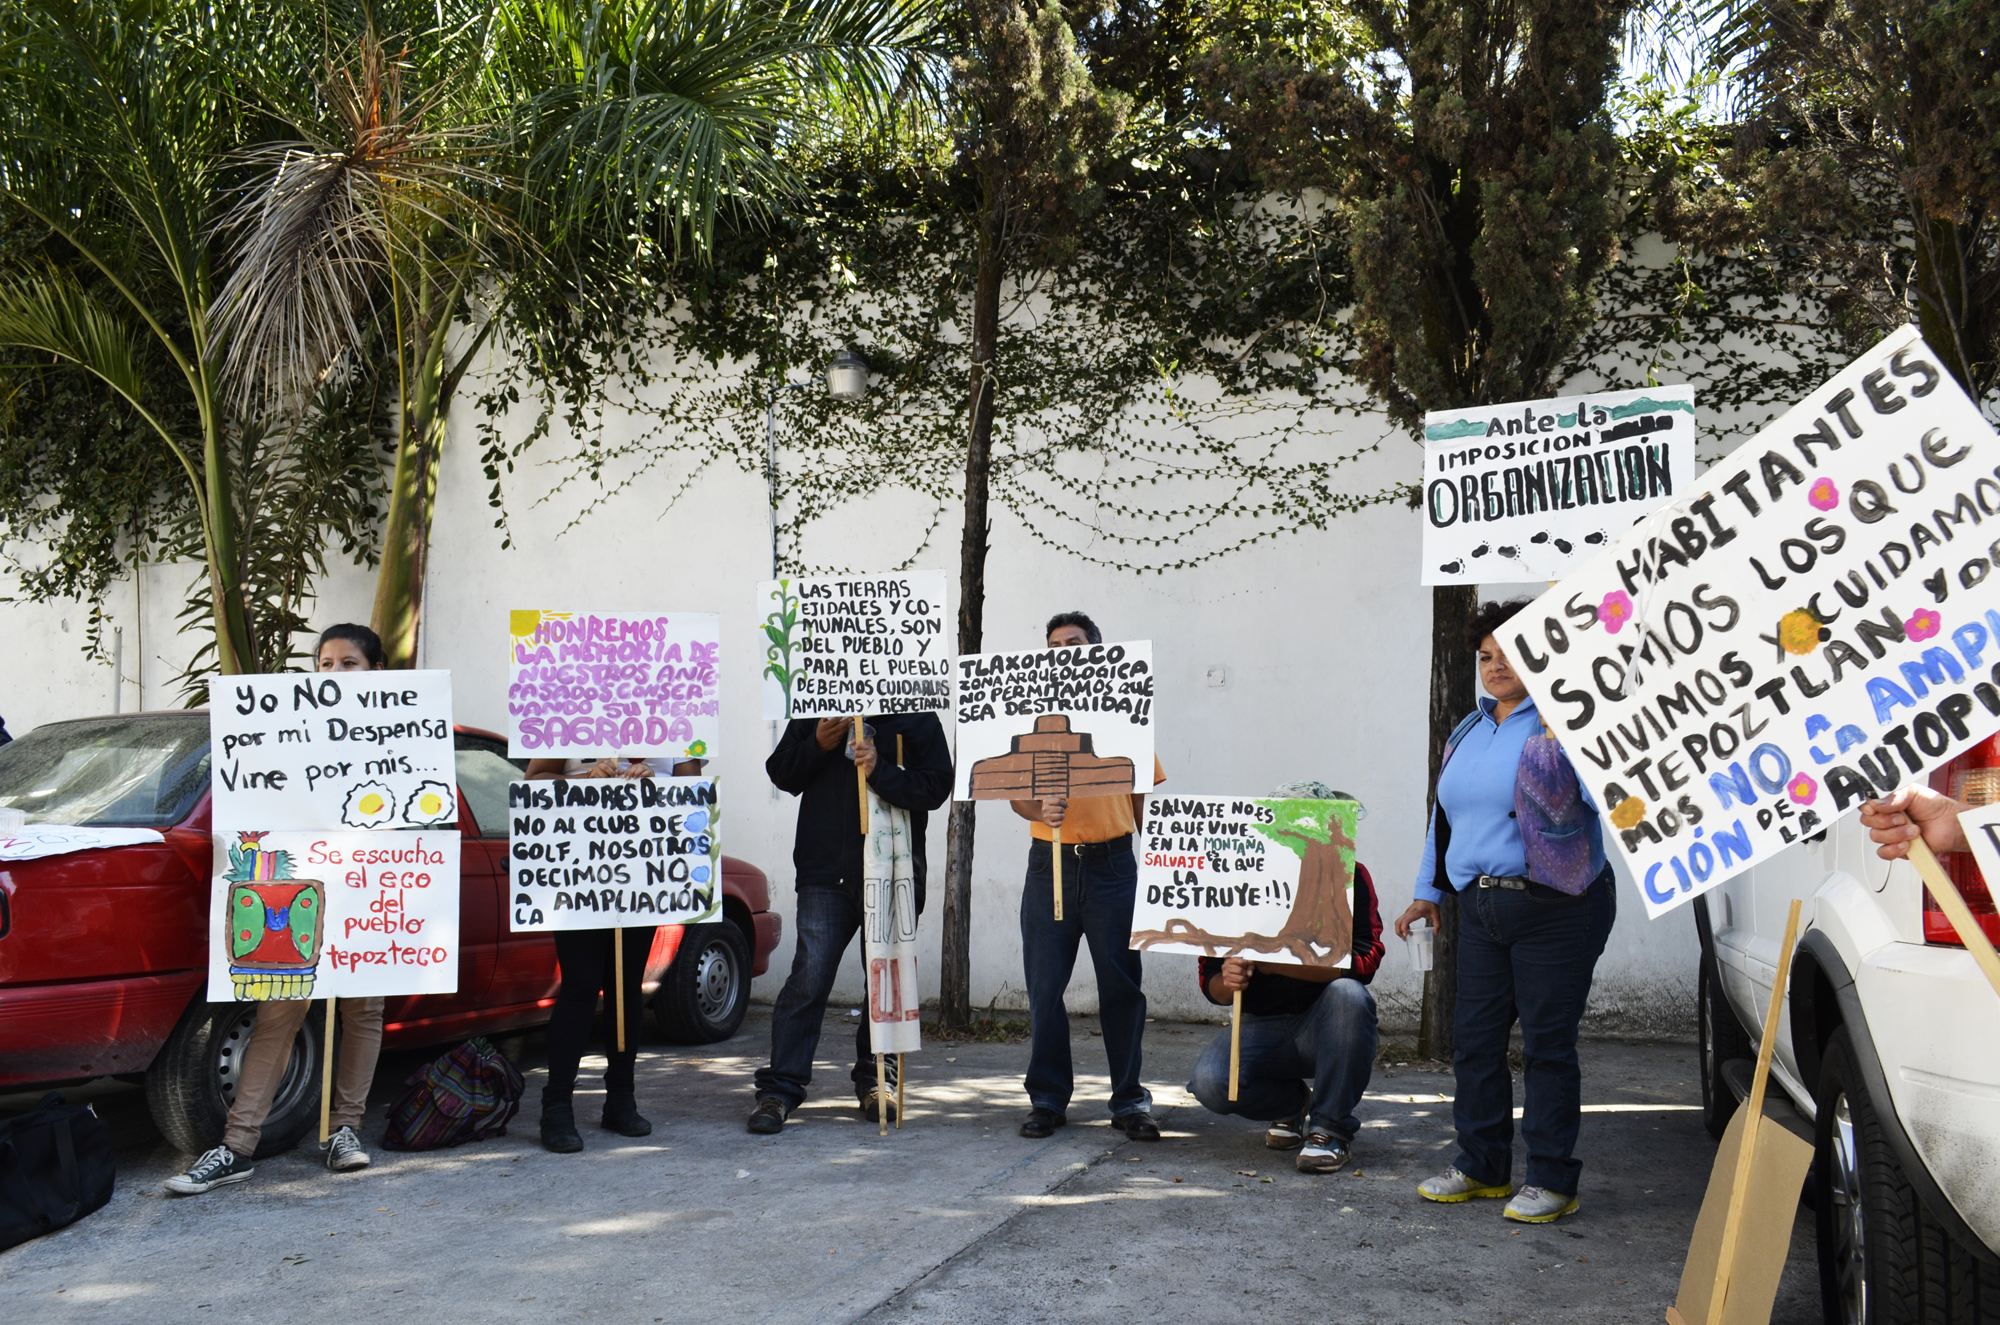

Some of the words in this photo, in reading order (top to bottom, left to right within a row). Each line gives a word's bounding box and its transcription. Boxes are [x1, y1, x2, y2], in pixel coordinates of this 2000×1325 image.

[1486, 407, 1555, 437] Ante
[1438, 431, 1591, 472] IMPOSICION
[1427, 436, 1672, 528] ORGANIZACIÓN
[1514, 591, 1599, 673] LOS
[1615, 349, 1940, 596] HABITANTES
[799, 582, 832, 599] LAS
[835, 580, 911, 598] TIERRAS
[1550, 582, 1740, 731] SOMOS
[1749, 516, 1846, 590] LOS
[1849, 427, 1972, 524] QUE
[1923, 567, 1948, 603] Y
[801, 600, 882, 616] EJIDALES
[890, 600, 901, 615] Y
[1581, 651, 1753, 770] VIVIMOS
[1808, 465, 2000, 624] CUIDAMO
[534, 614, 668, 644] HONREMOS
[802, 617, 896, 635] MUNALES,
[900, 617, 941, 634] SON
[515, 644, 556, 665] LA
[559, 640, 683, 665] MEMORIA
[689, 640, 719, 663] DE
[801, 637, 835, 654] DEL
[842, 636, 904, 656] PUEBLO
[916, 638, 931, 657] Y
[517, 663, 651, 685] NUESTROS
[804, 657, 849, 678] PARA
[859, 659, 880, 676] EL
[888, 658, 949, 676] PUEBLO
[959, 645, 1125, 678] TLAXOMOLCO
[959, 675, 1003, 691] ZONA
[1005, 660, 1149, 685] ARQUEOLOGICA
[236, 684, 278, 715] Yo
[293, 678, 342, 711] NO
[357, 689, 418, 709] vine
[508, 682, 615, 702] PASADOS
[797, 677, 874, 695] DEBEMOS
[959, 690, 986, 705] NO
[990, 679, 1114, 702] PERMITAMOS
[1118, 676, 1153, 697] QUE
[508, 700, 593, 717] VANDO
[602, 701, 642, 719] SU
[644, 699, 719, 717] TIERRA
[792, 697, 864, 714] AMARLAS
[958, 703, 996, 724] SEA
[222, 730, 266, 759] por
[278, 719, 311, 743] mi
[328, 718, 448, 745] Despensa
[518, 715, 694, 750] SAGRADA
[1804, 713, 1833, 741] A
[1809, 723, 1868, 765] LA
[220, 758, 288, 792] Vine
[306, 761, 353, 792] por
[1644, 818, 1753, 905] CIÓN
[1756, 798, 1795, 831] DE
[1779, 809, 1821, 844] LA
[1823, 662, 2000, 813] AUTOPI
[1708, 743, 1792, 811] NO
[514, 815, 545, 836] NO
[583, 814, 640, 834] CLUB
[650, 814, 683, 836] DE
[1149, 798, 1225, 818] SALVAJE
[1231, 801, 1254, 816] NO
[1254, 806, 1274, 824] ES
[1620, 793, 1703, 853] MOS
[1146, 820, 1164, 836] EL
[1170, 821, 1204, 836] QUE
[1208, 820, 1249, 837] VIVE
[307, 840, 343, 865] Se
[352, 837, 445, 865] escucha
[589, 835, 711, 861] NOSOTROS
[1148, 837, 1173, 851] EN
[1179, 837, 1198, 851] LA
[1203, 835, 1265, 856] MONTAÑA
[1206, 851, 1220, 861] ES
[646, 857, 690, 886] NO
[1144, 852, 1206, 869] SALVAJE
[1211, 858, 1230, 872] EL
[1234, 857, 1265, 872] QUE
[345, 866, 367, 888] el
[379, 871, 431, 888] eco
[1173, 870, 1198, 886] LA
[369, 889, 404, 913] del
[515, 908, 544, 925] LA
[554, 882, 714, 914] AMPLIACIÓN
[344, 911, 425, 939] pueblo
[326, 939, 447, 973] tepozteco
